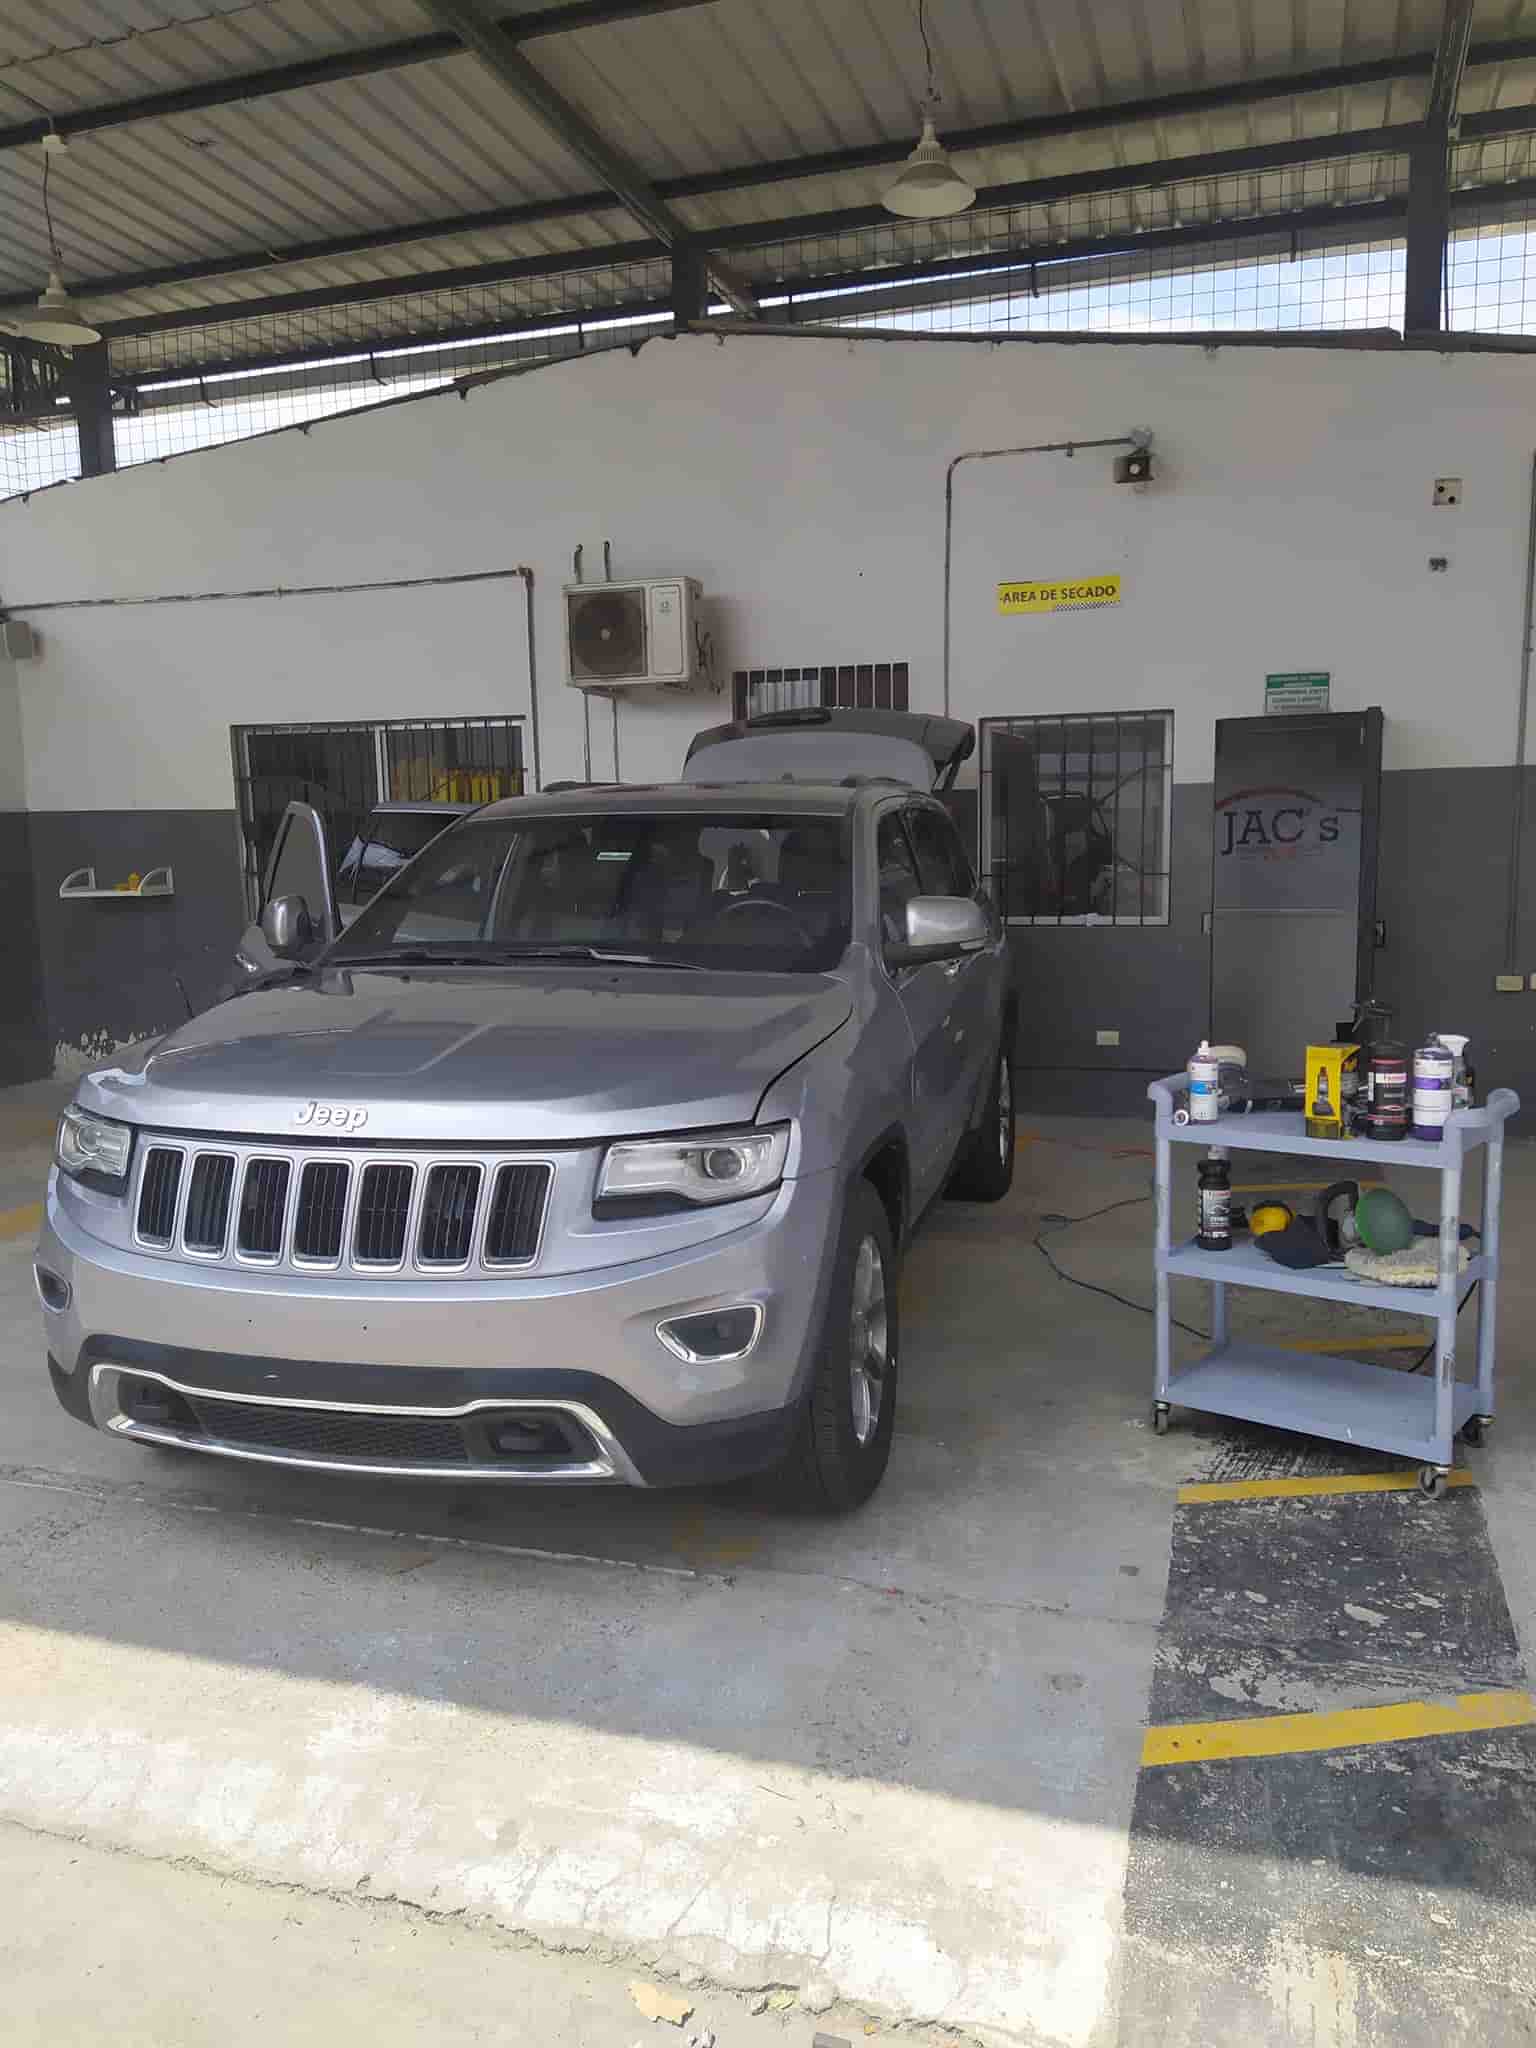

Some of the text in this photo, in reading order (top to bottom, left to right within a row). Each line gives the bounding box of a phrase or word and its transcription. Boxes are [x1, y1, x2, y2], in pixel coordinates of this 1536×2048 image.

[1002, 584, 1117, 605] AREA DE SECADO
[295, 1100, 369, 1132] Jeep
